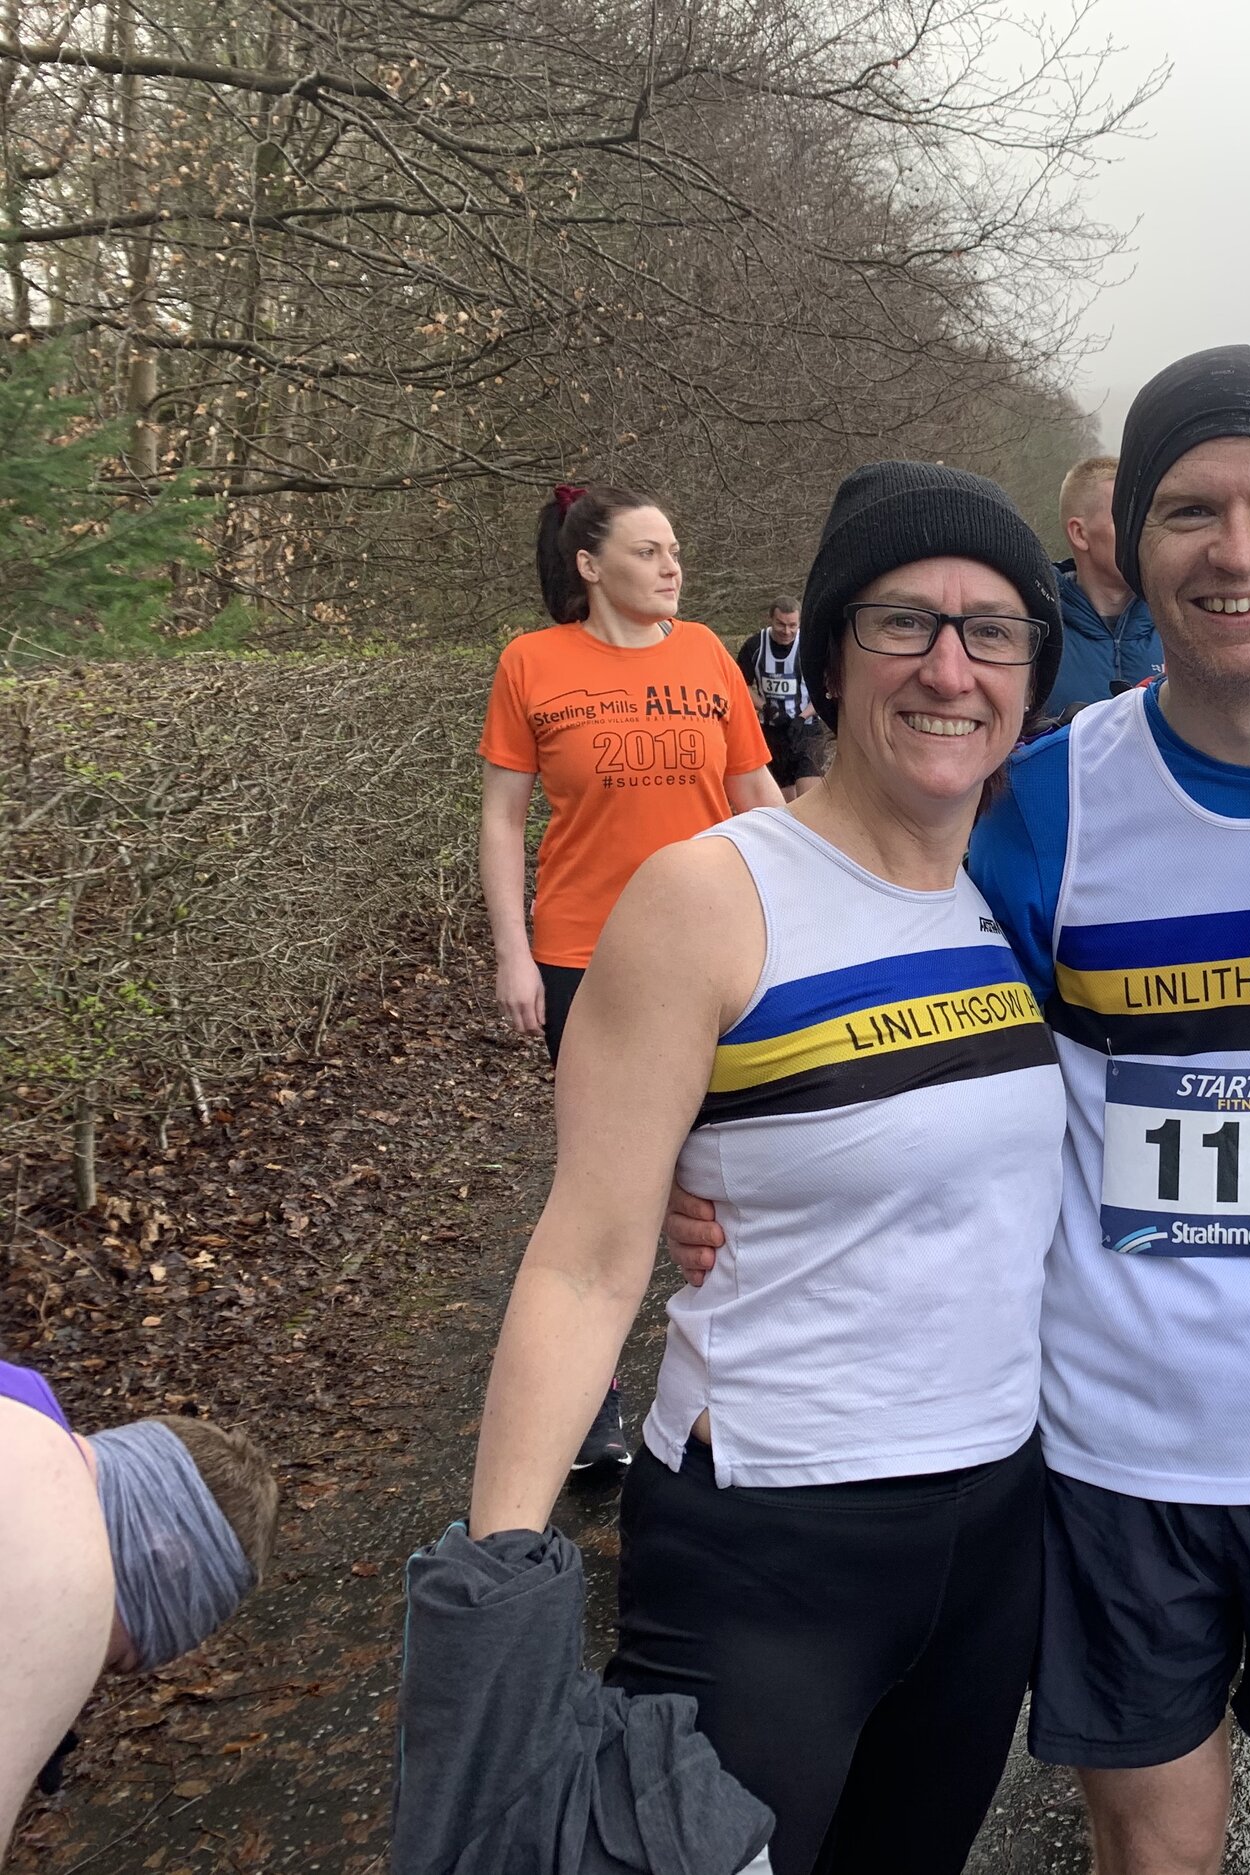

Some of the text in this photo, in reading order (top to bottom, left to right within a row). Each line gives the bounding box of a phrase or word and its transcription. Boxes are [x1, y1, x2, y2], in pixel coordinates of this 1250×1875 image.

[766, 679, 790, 693] 370
[533, 700, 638, 727] Sterling Mills
[592, 728, 706, 774] 2019
[602, 774, 697, 789] #success
[845, 989, 1025, 1051] LINLITHGOW
